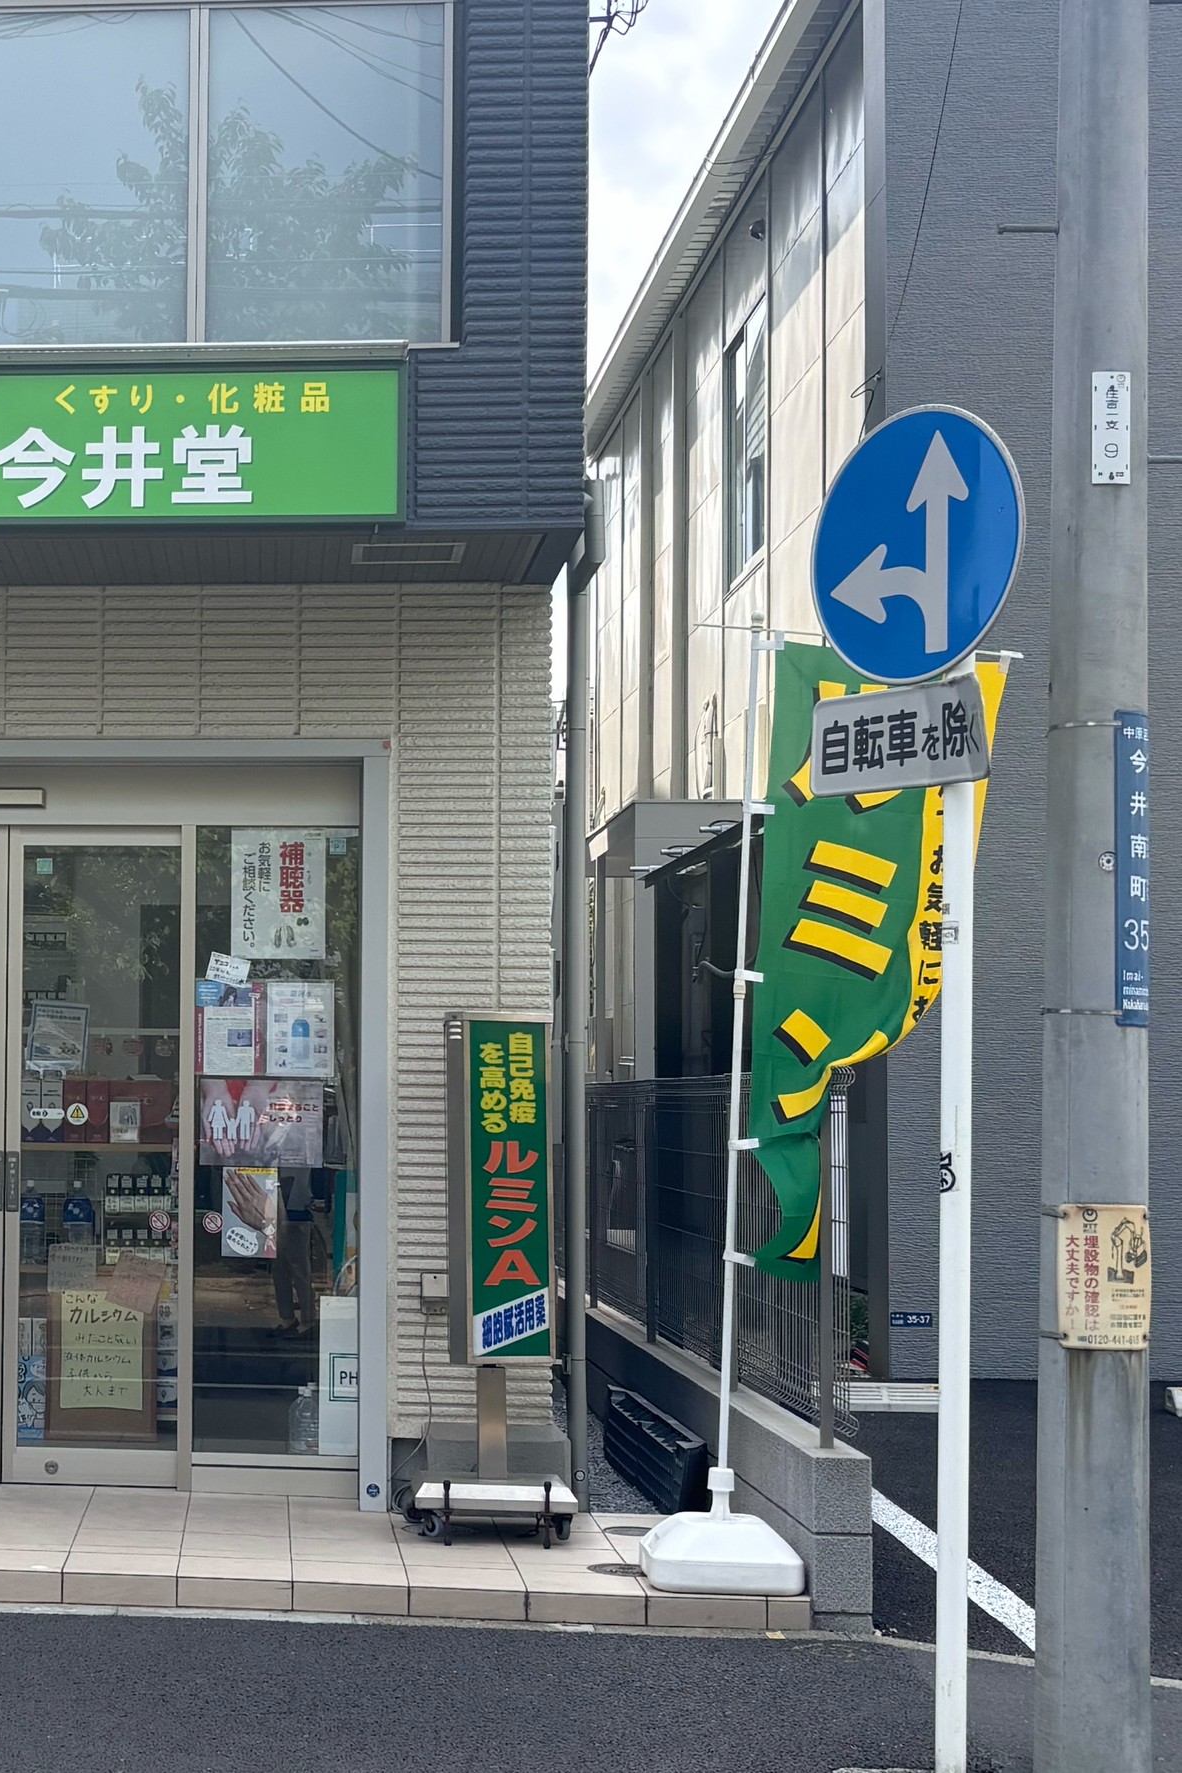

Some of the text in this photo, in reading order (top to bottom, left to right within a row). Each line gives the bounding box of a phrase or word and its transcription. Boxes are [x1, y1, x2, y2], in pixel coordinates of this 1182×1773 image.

[55, 382, 330, 414] くすり・化粧品
[821, 700, 980, 776] 自転車を除く
[1129, 748, 1149, 903] 今井南町
[242, 852, 256, 948] ご相談ください。
[258, 842, 272, 892] お気軽に
[279, 842, 304, 913] 補聴器
[1124, 919, 1149, 951] 35
[479, 1043, 507, 1133] を高める
[509, 1032, 536, 1124] 自己免疫
[482, 1141, 541, 1286] ルミンA
[66, 1294, 98, 1304] こんな
[70, 1306, 138, 1324] カルシウム
[1084, 1235, 1100, 1331] 埋設物の確認は
